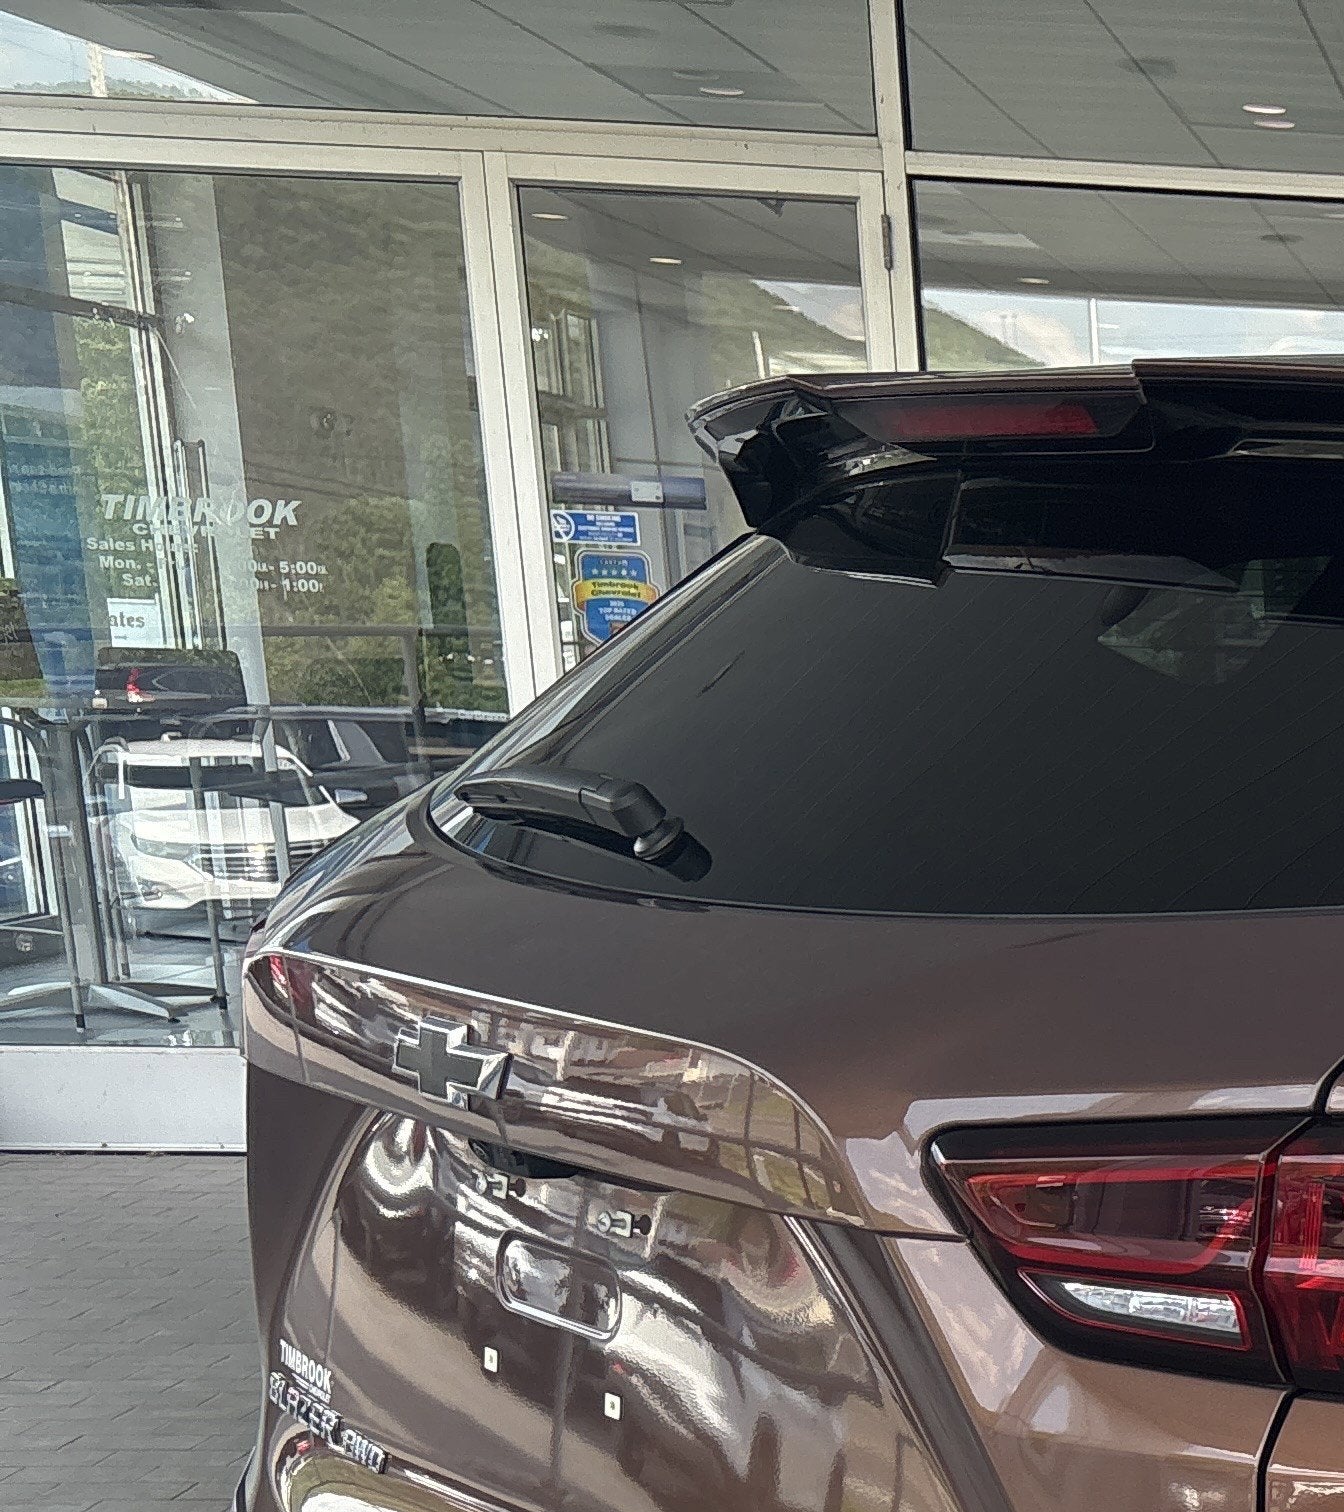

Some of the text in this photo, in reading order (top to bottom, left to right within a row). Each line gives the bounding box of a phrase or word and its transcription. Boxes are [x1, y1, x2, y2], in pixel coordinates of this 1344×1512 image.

[86, 537, 136, 551] Sales
[99, 556, 142, 570] Mon.
[122, 574, 159, 587] Sat.
[279, 1338, 332, 1395] TIMBROOK
